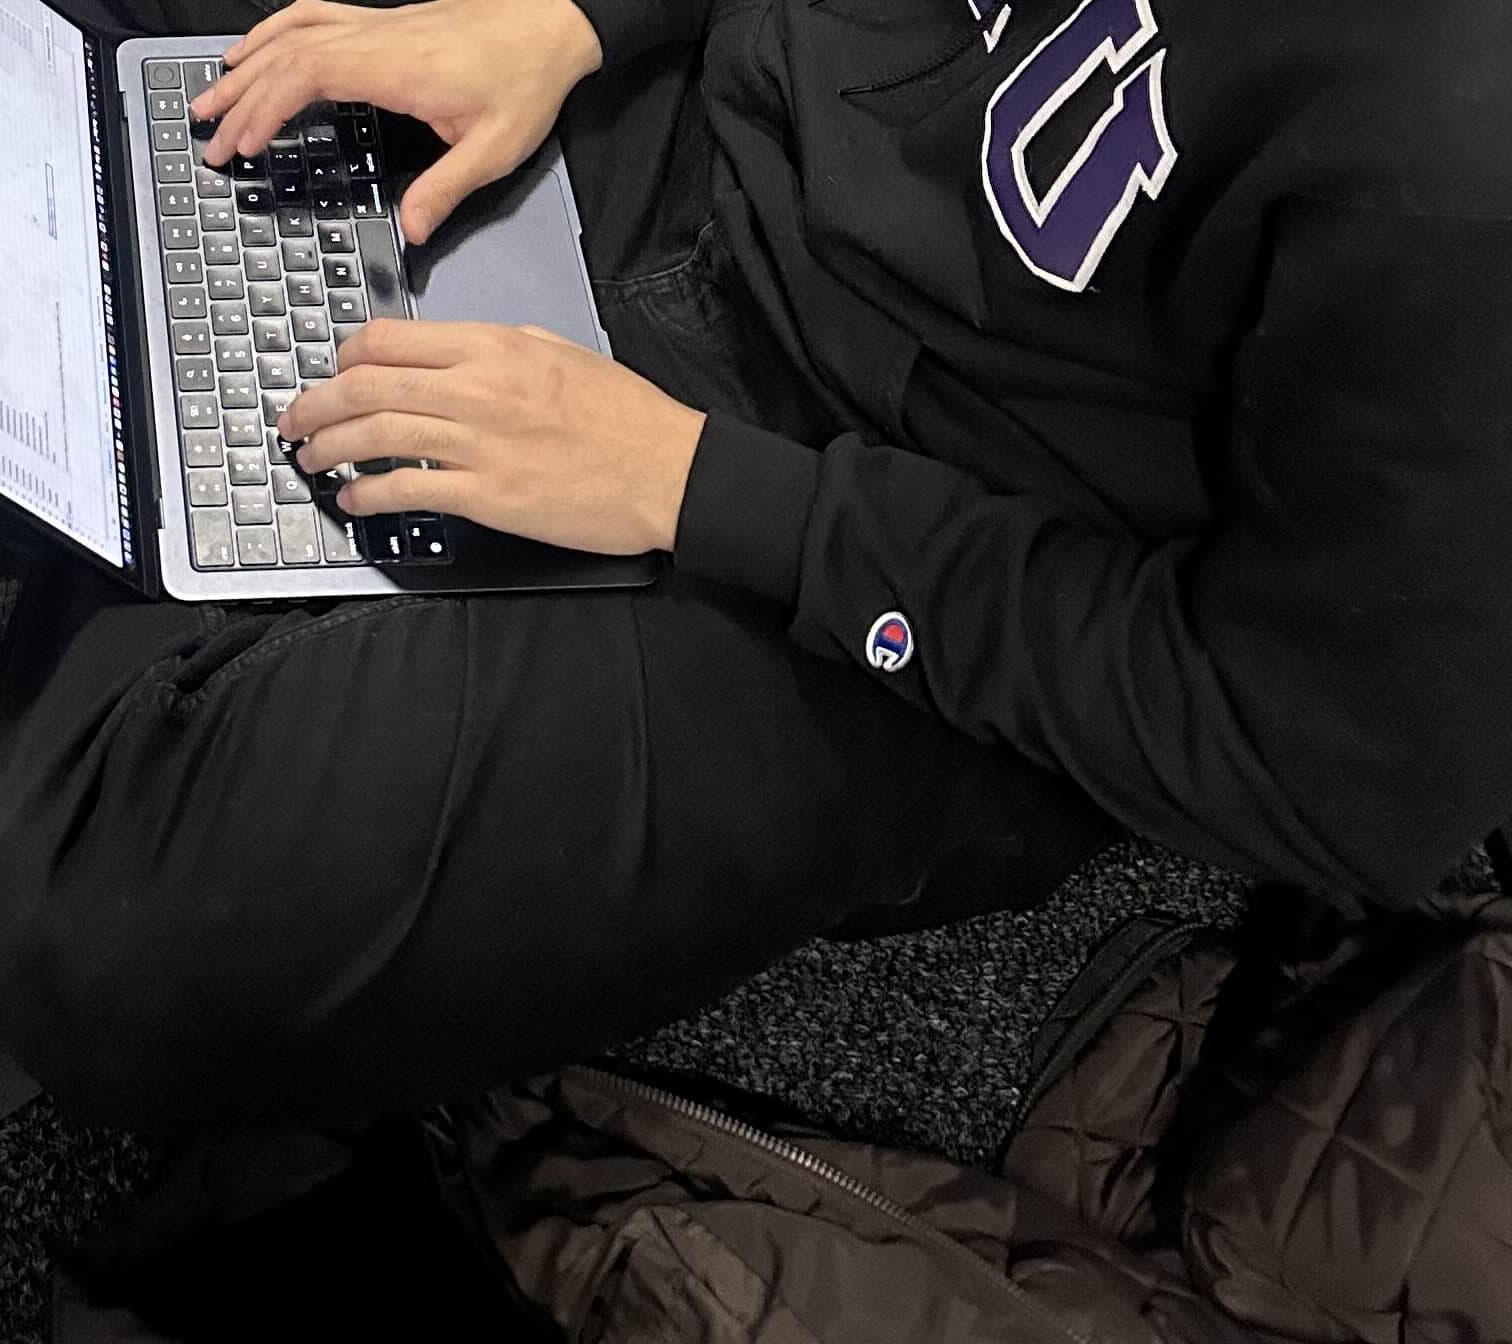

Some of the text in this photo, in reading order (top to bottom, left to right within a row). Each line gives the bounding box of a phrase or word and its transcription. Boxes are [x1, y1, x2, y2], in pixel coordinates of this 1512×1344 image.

[243, 161, 254, 169] P
[248, 194, 259, 202] O
[289, 217, 300, 225] K
[256, 261, 268, 269] U
[330, 232, 353, 310] B N M
[299, 285, 310, 294] H
[261, 295, 273, 304] Y
[305, 320, 316, 329] G
[266, 331, 277, 340] T
[309, 357, 321, 365] F
[271, 367, 283, 376] R
[275, 402, 287, 412] E
[281, 441, 292, 452] W
[286, 480, 298, 490] Q
